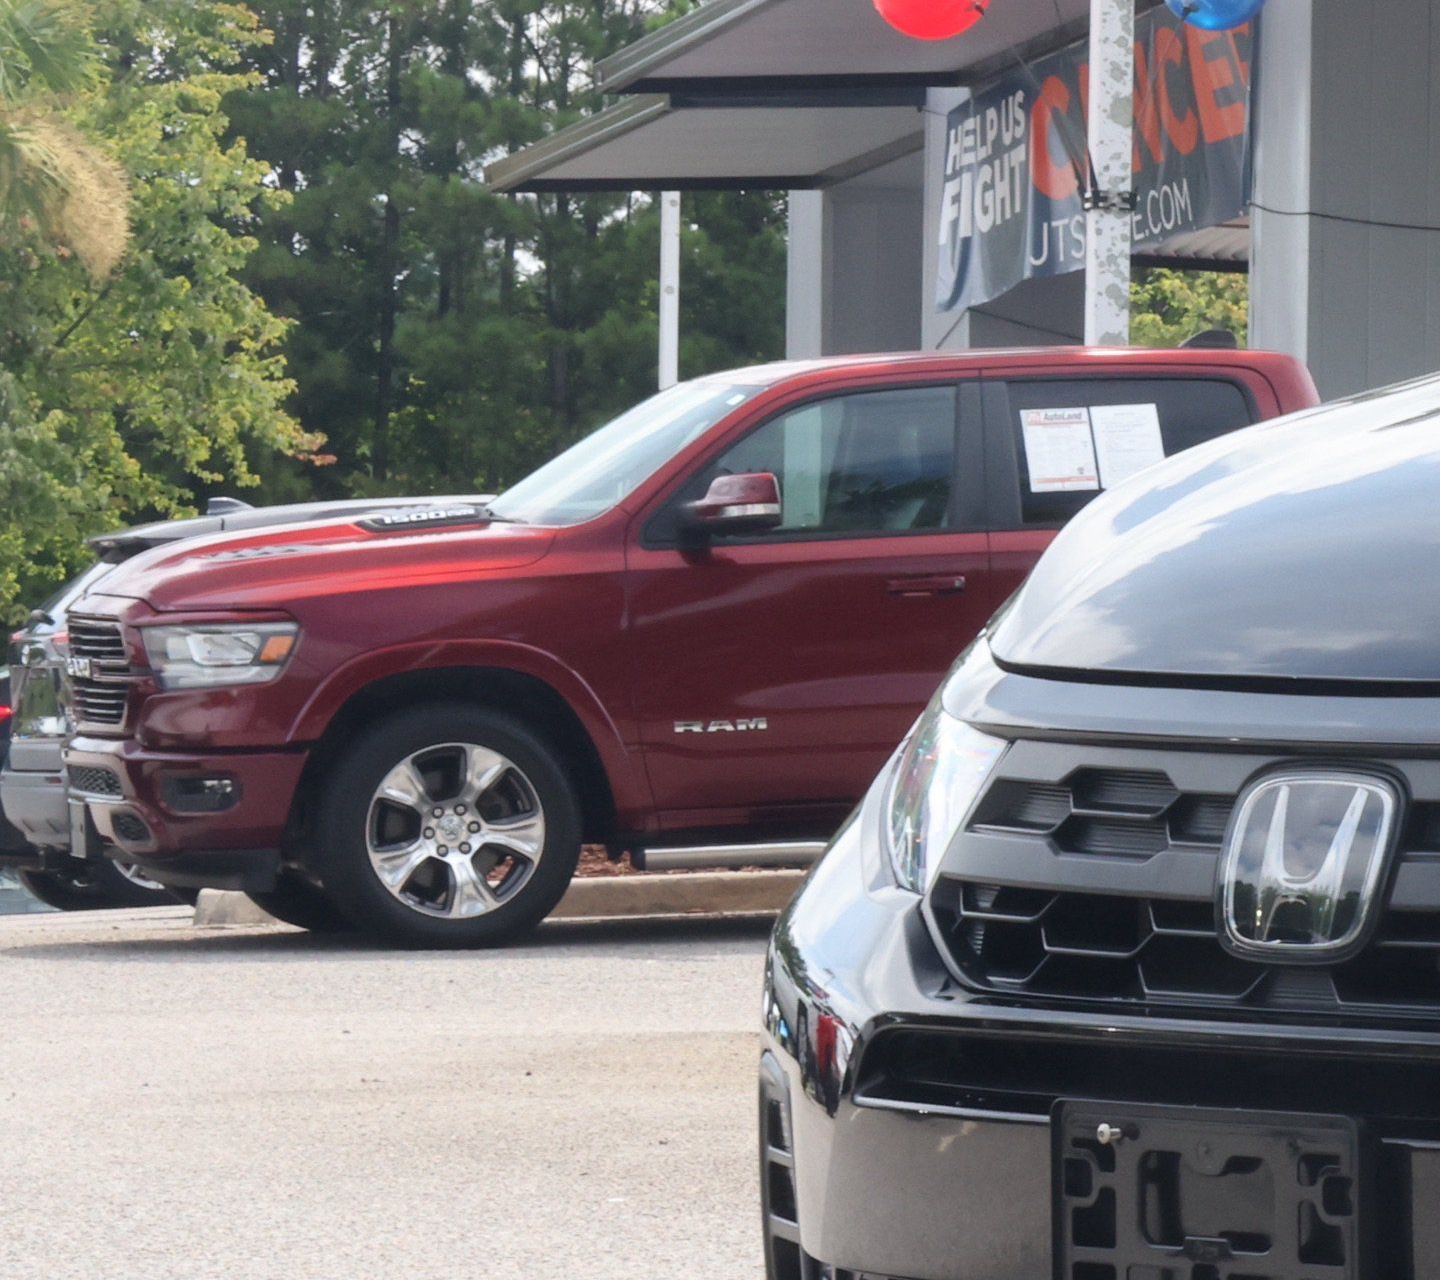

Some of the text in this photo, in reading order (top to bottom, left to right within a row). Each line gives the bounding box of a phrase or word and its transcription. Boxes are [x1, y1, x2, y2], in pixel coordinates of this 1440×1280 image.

[946, 89, 1025, 175] HELP US
[938, 143, 1027, 245] FIGHT
[673, 717, 768, 733] RAM
